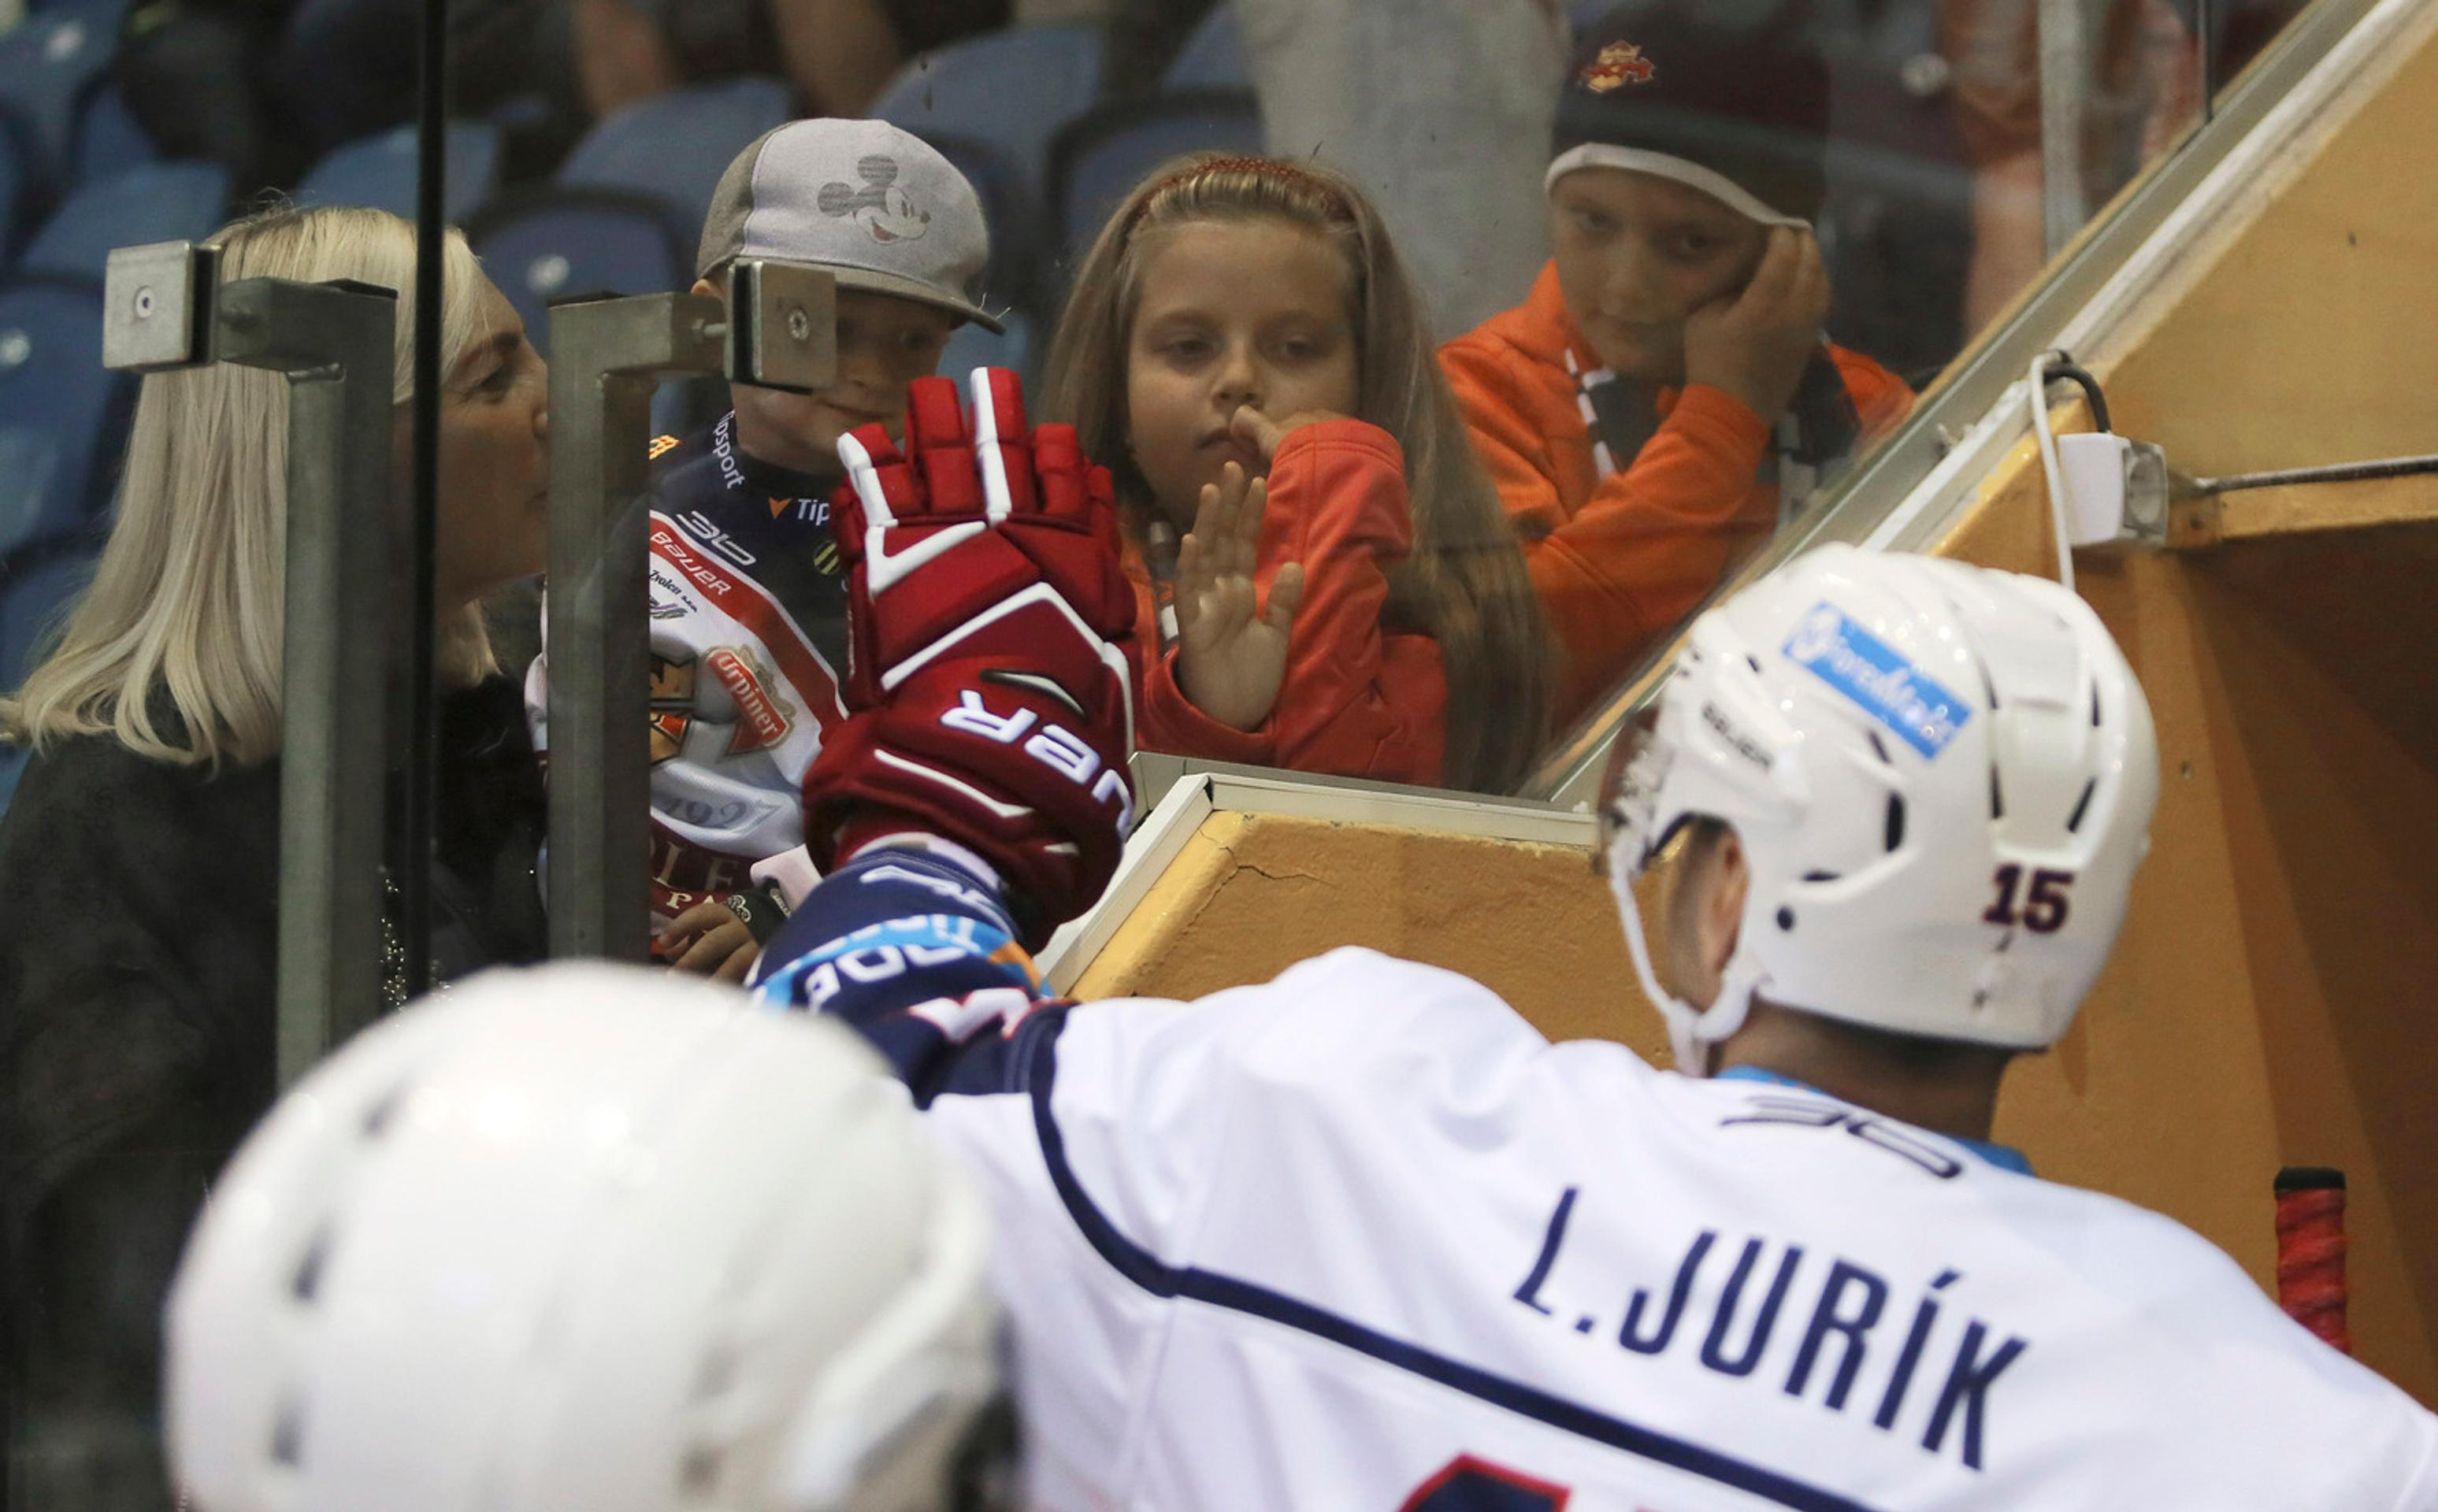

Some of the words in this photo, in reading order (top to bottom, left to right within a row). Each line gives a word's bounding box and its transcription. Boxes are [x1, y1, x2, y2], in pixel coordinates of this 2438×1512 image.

[797, 498, 830, 526] Tip
[650, 531, 732, 596] BAUER
[715, 653, 778, 738] Urpiner
[1981, 862, 2076, 936] 15
